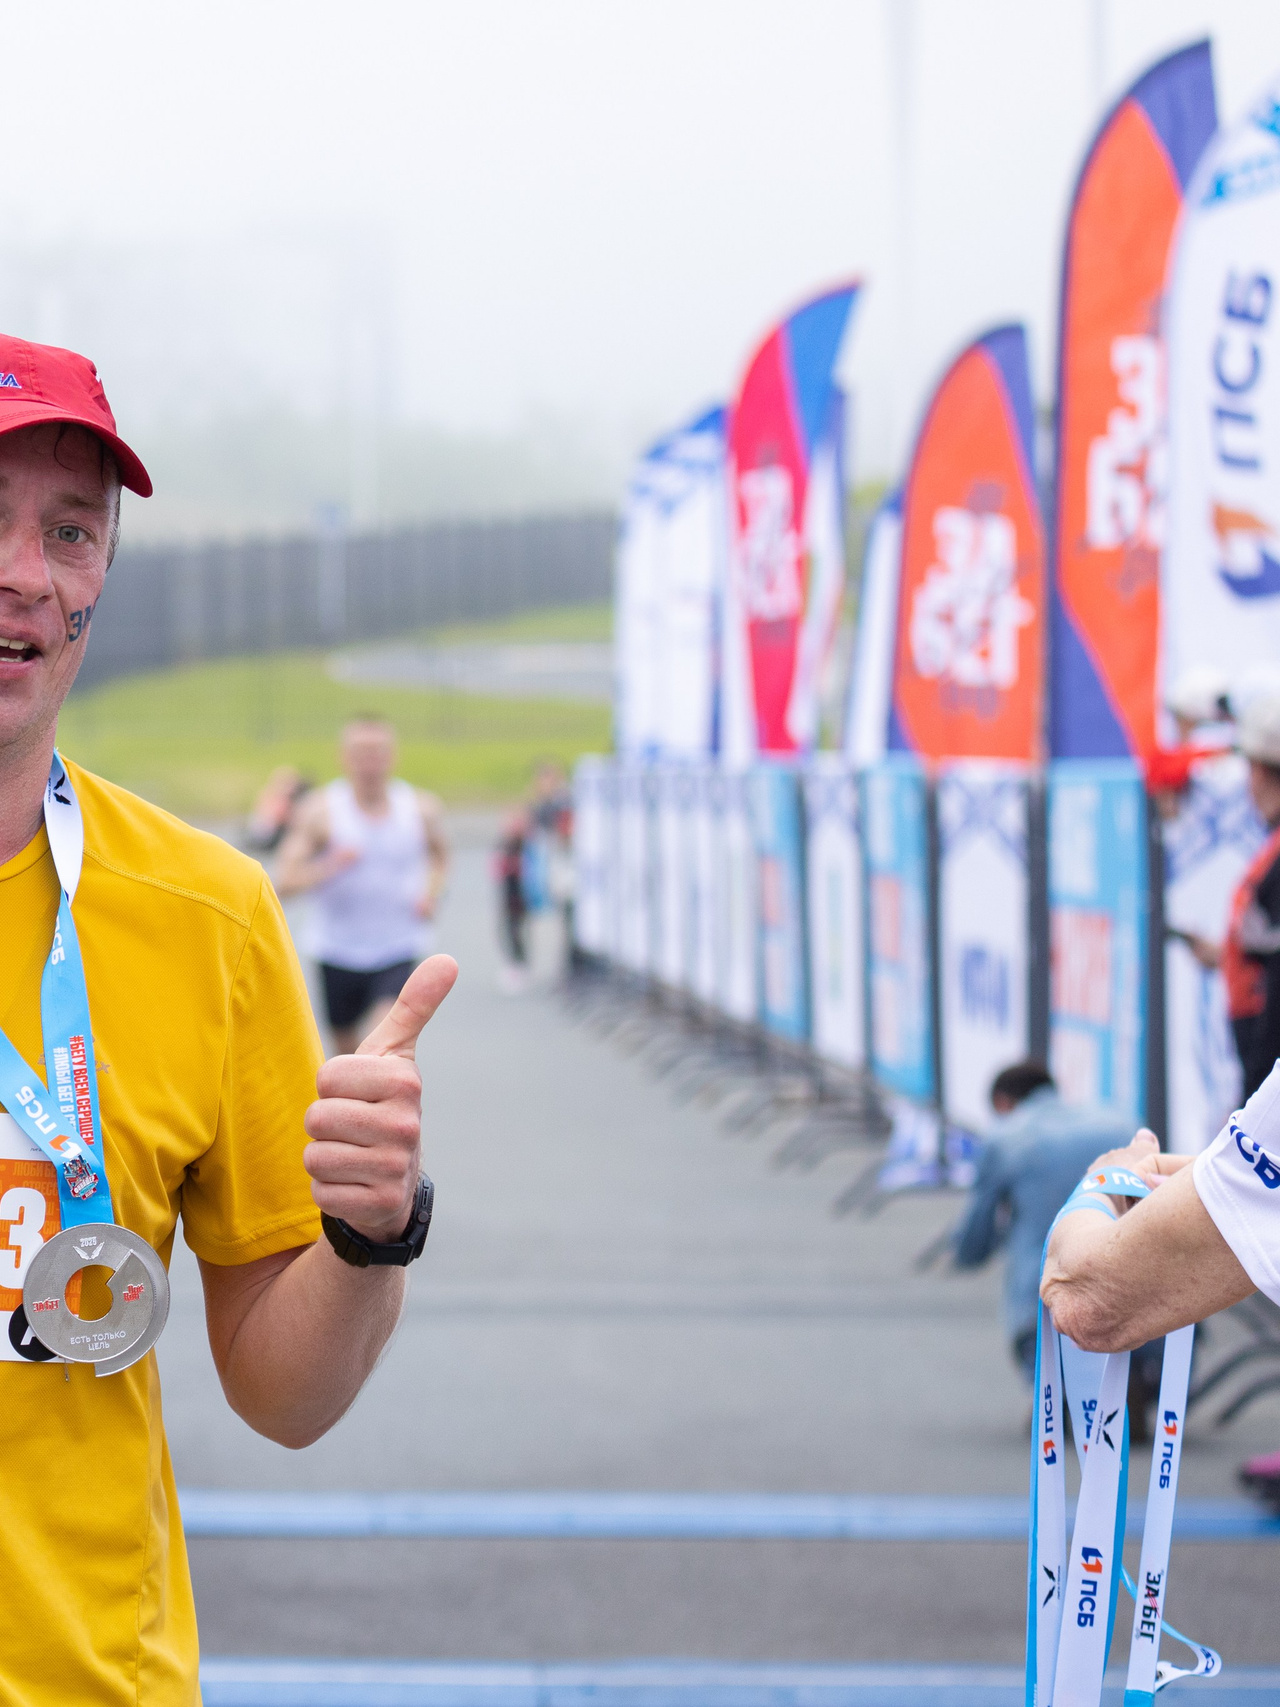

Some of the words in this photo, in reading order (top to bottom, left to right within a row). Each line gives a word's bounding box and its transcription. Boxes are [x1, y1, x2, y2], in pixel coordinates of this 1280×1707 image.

[1213, 268, 1274, 474] ПСБ
[69, 1035, 87, 1066] #БЕГУ
[57, 1085, 74, 1103] БЕГ
[73, 1067, 90, 1096] ВСЕМ
[15, 1085, 58, 1135] ПСБ
[60, 1104, 75, 1113] В
[76, 1098, 95, 1146] СЕРДЦЕМ
[1112, 1171, 1151, 1190] ПС
[69, 1336, 91, 1345] ЕСТЬ
[92, 1330, 126, 1342] ТОЛЬКО
[1043, 1383, 1054, 1434] ПСБ
[1159, 1442, 1174, 1490] ПСБ
[1077, 1579, 1098, 1629] ПСБ
